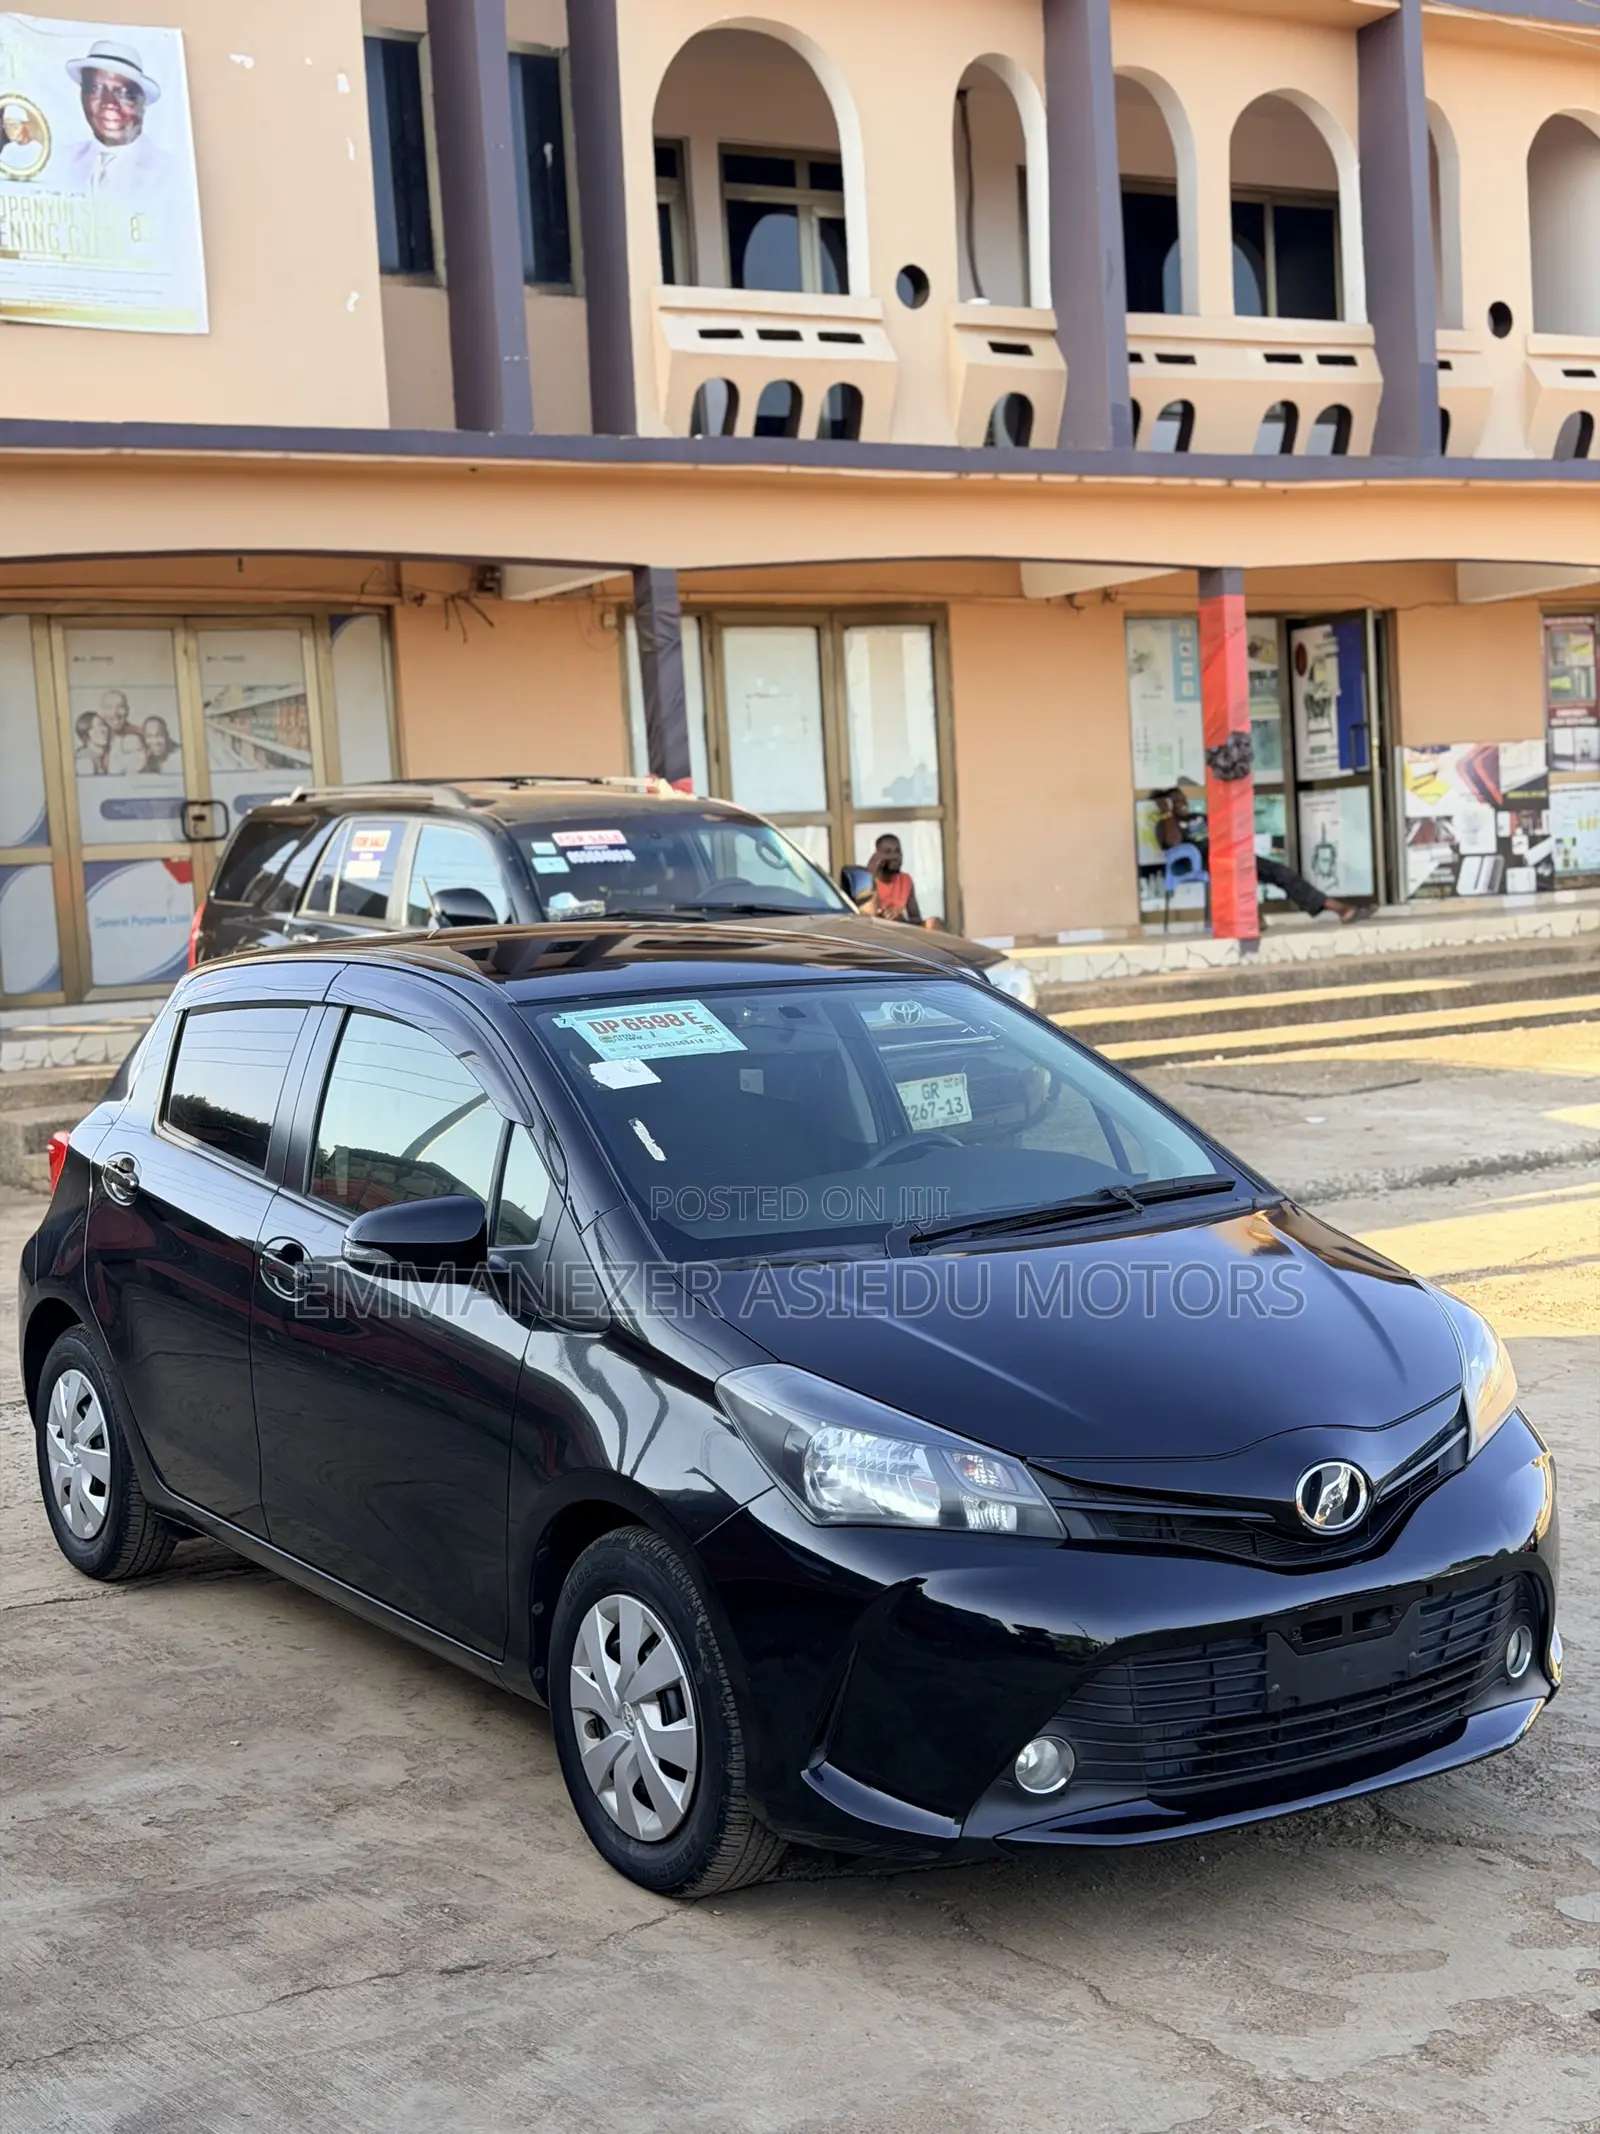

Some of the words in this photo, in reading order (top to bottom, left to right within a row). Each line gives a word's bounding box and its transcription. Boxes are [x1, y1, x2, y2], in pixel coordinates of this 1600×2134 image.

[587, 1020, 621, 1035] DP
[621, 1013, 685, 1031] 6598
[684, 1011, 704, 1025] E
[921, 1082, 941, 1101] GR
